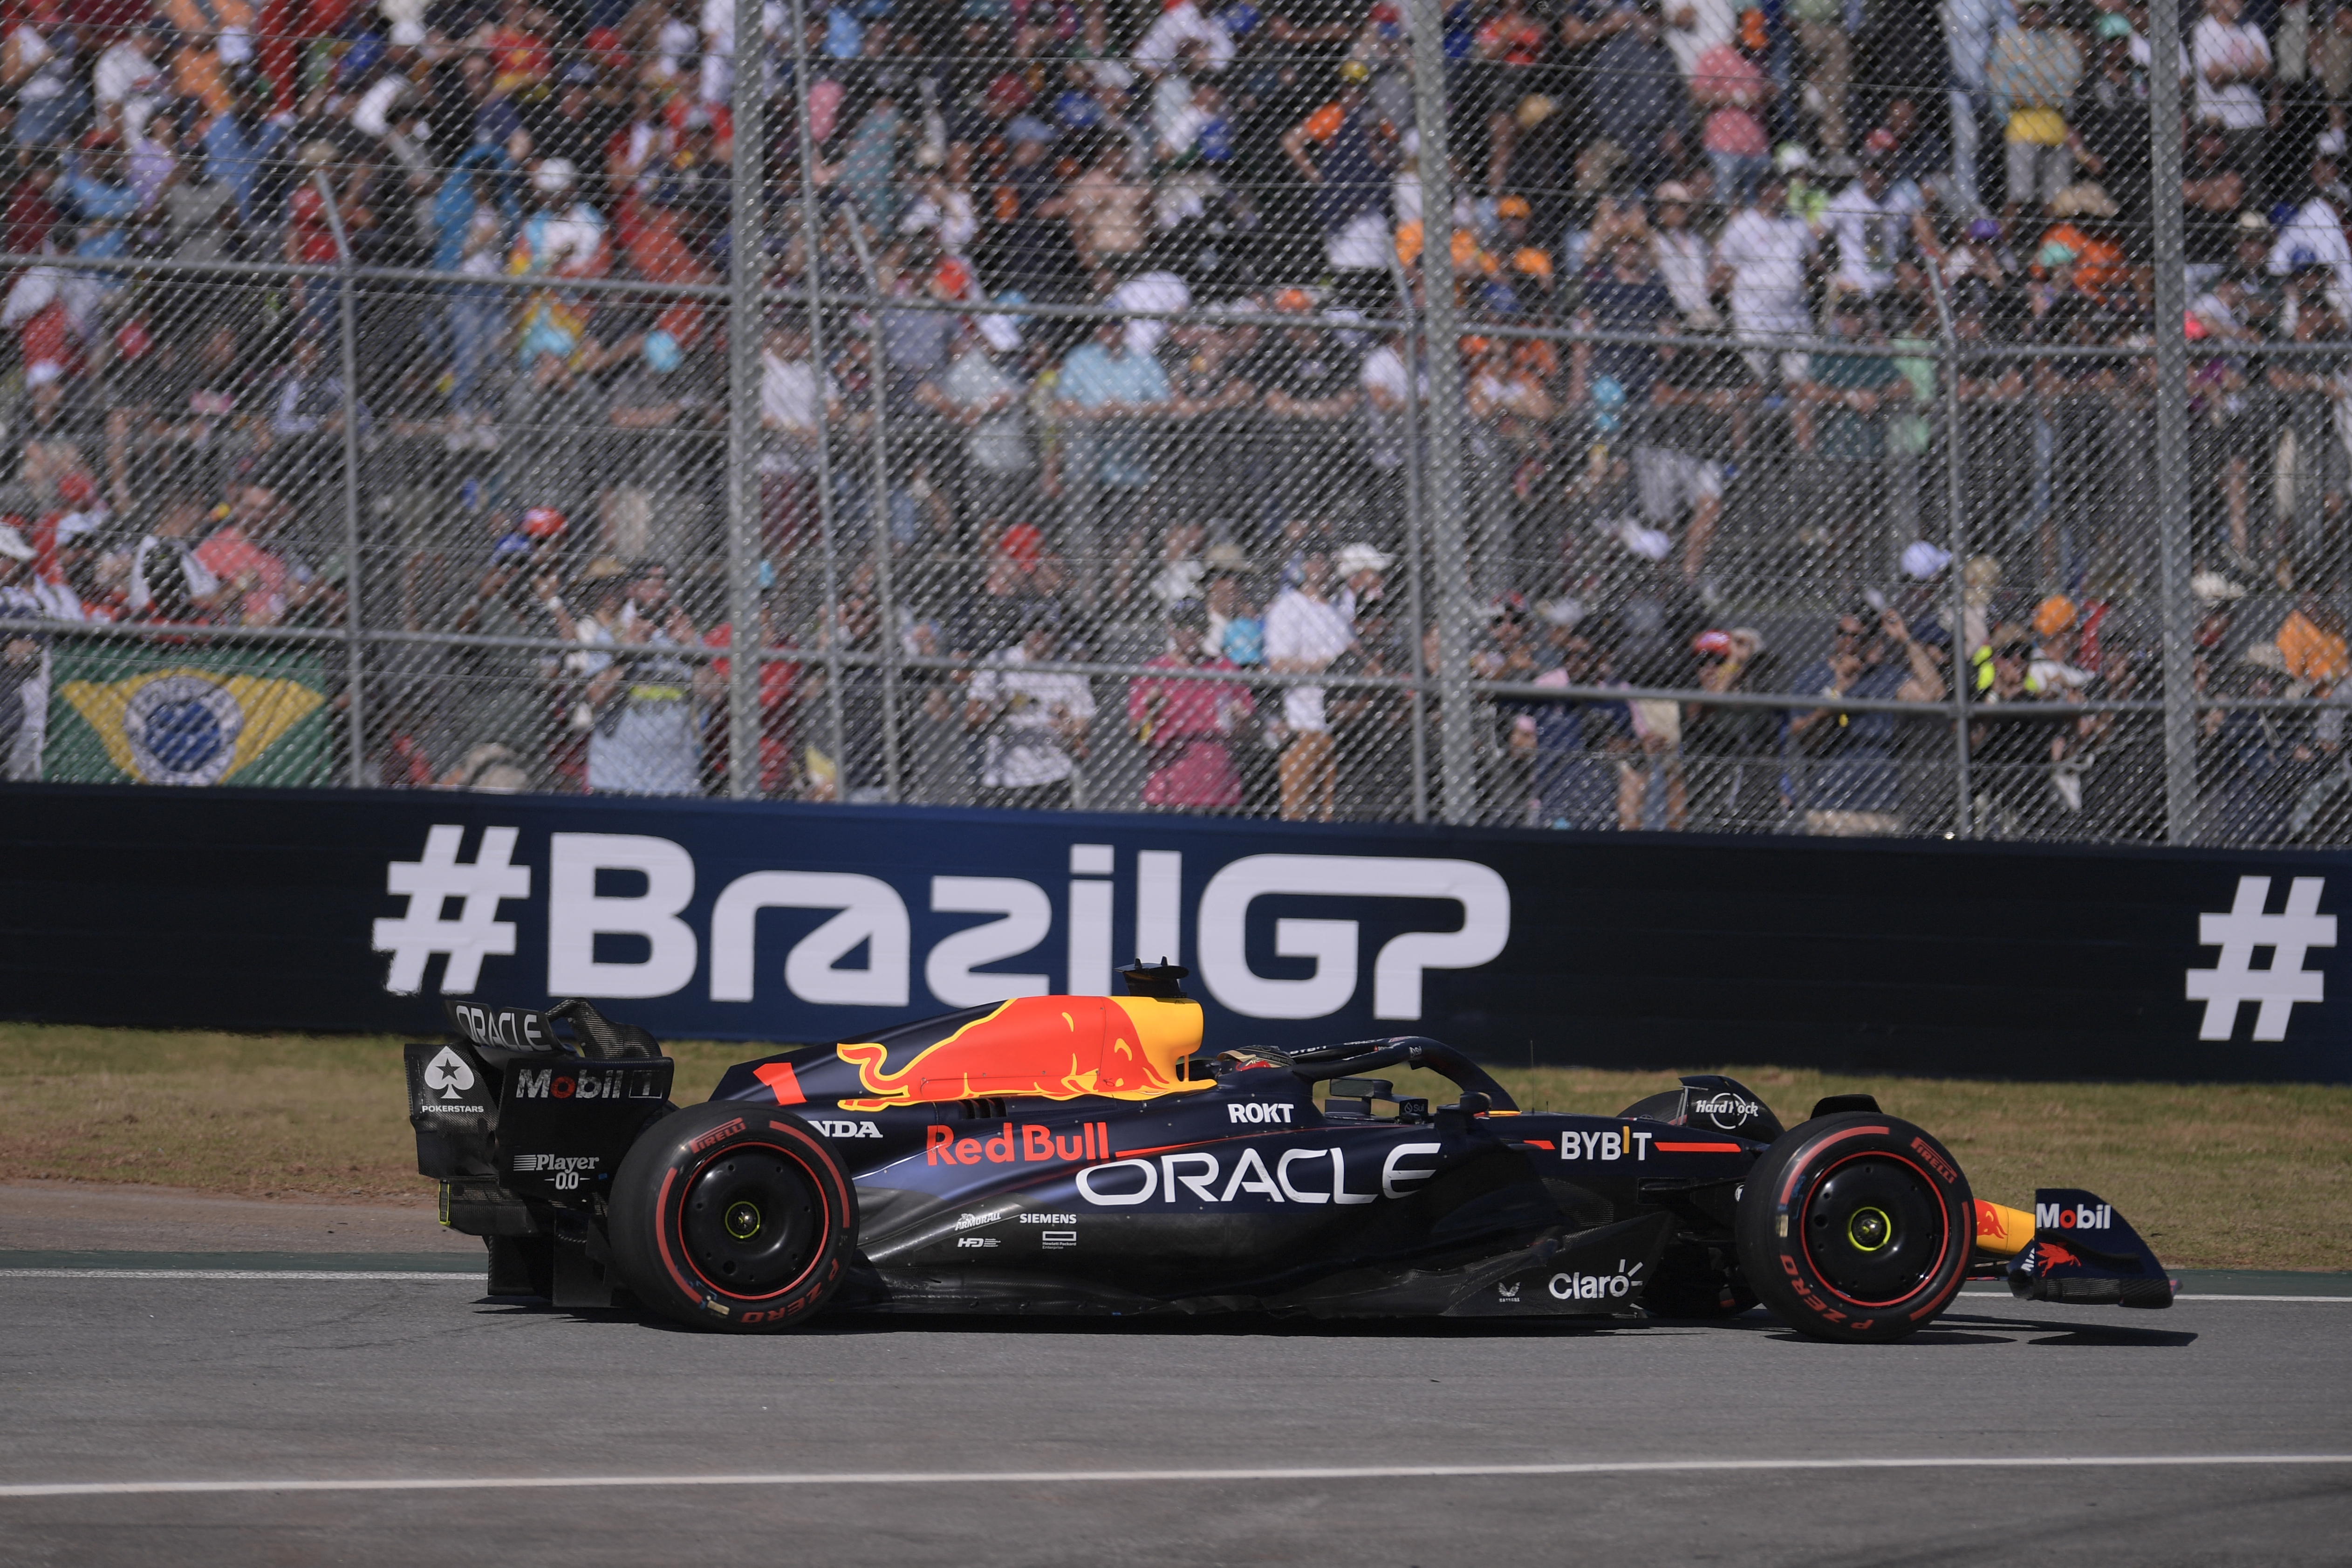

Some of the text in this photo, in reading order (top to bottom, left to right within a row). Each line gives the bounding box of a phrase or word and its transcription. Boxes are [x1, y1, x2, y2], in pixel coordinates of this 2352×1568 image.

[372, 824, 1511, 1021] #BrazilGP
[456, 1005, 553, 1052] ORACLE
[516, 1069, 624, 1099] Mobil
[753, 1062, 807, 1106] 1
[1227, 1102, 1294, 1123] ROKT
[1695, 1100, 1728, 1114] Hard
[688, 1117, 746, 1154] PIRELLI
[807, 1120, 884, 1138] NDA
[926, 1122, 1109, 1166] Red Bull
[1561, 1125, 1652, 1161] BYBIT
[536, 1153, 600, 1173] Player
[1075, 1143, 1442, 1206] ORACLE
[1910, 1136, 1958, 1184] PIRELLI
[555, 1171, 579, 1190] 0.0
[1019, 1213, 1077, 1224] SIEMENS
[2036, 1203, 2112, 1230] Mobil
[1548, 1272, 1630, 1299] Claro
